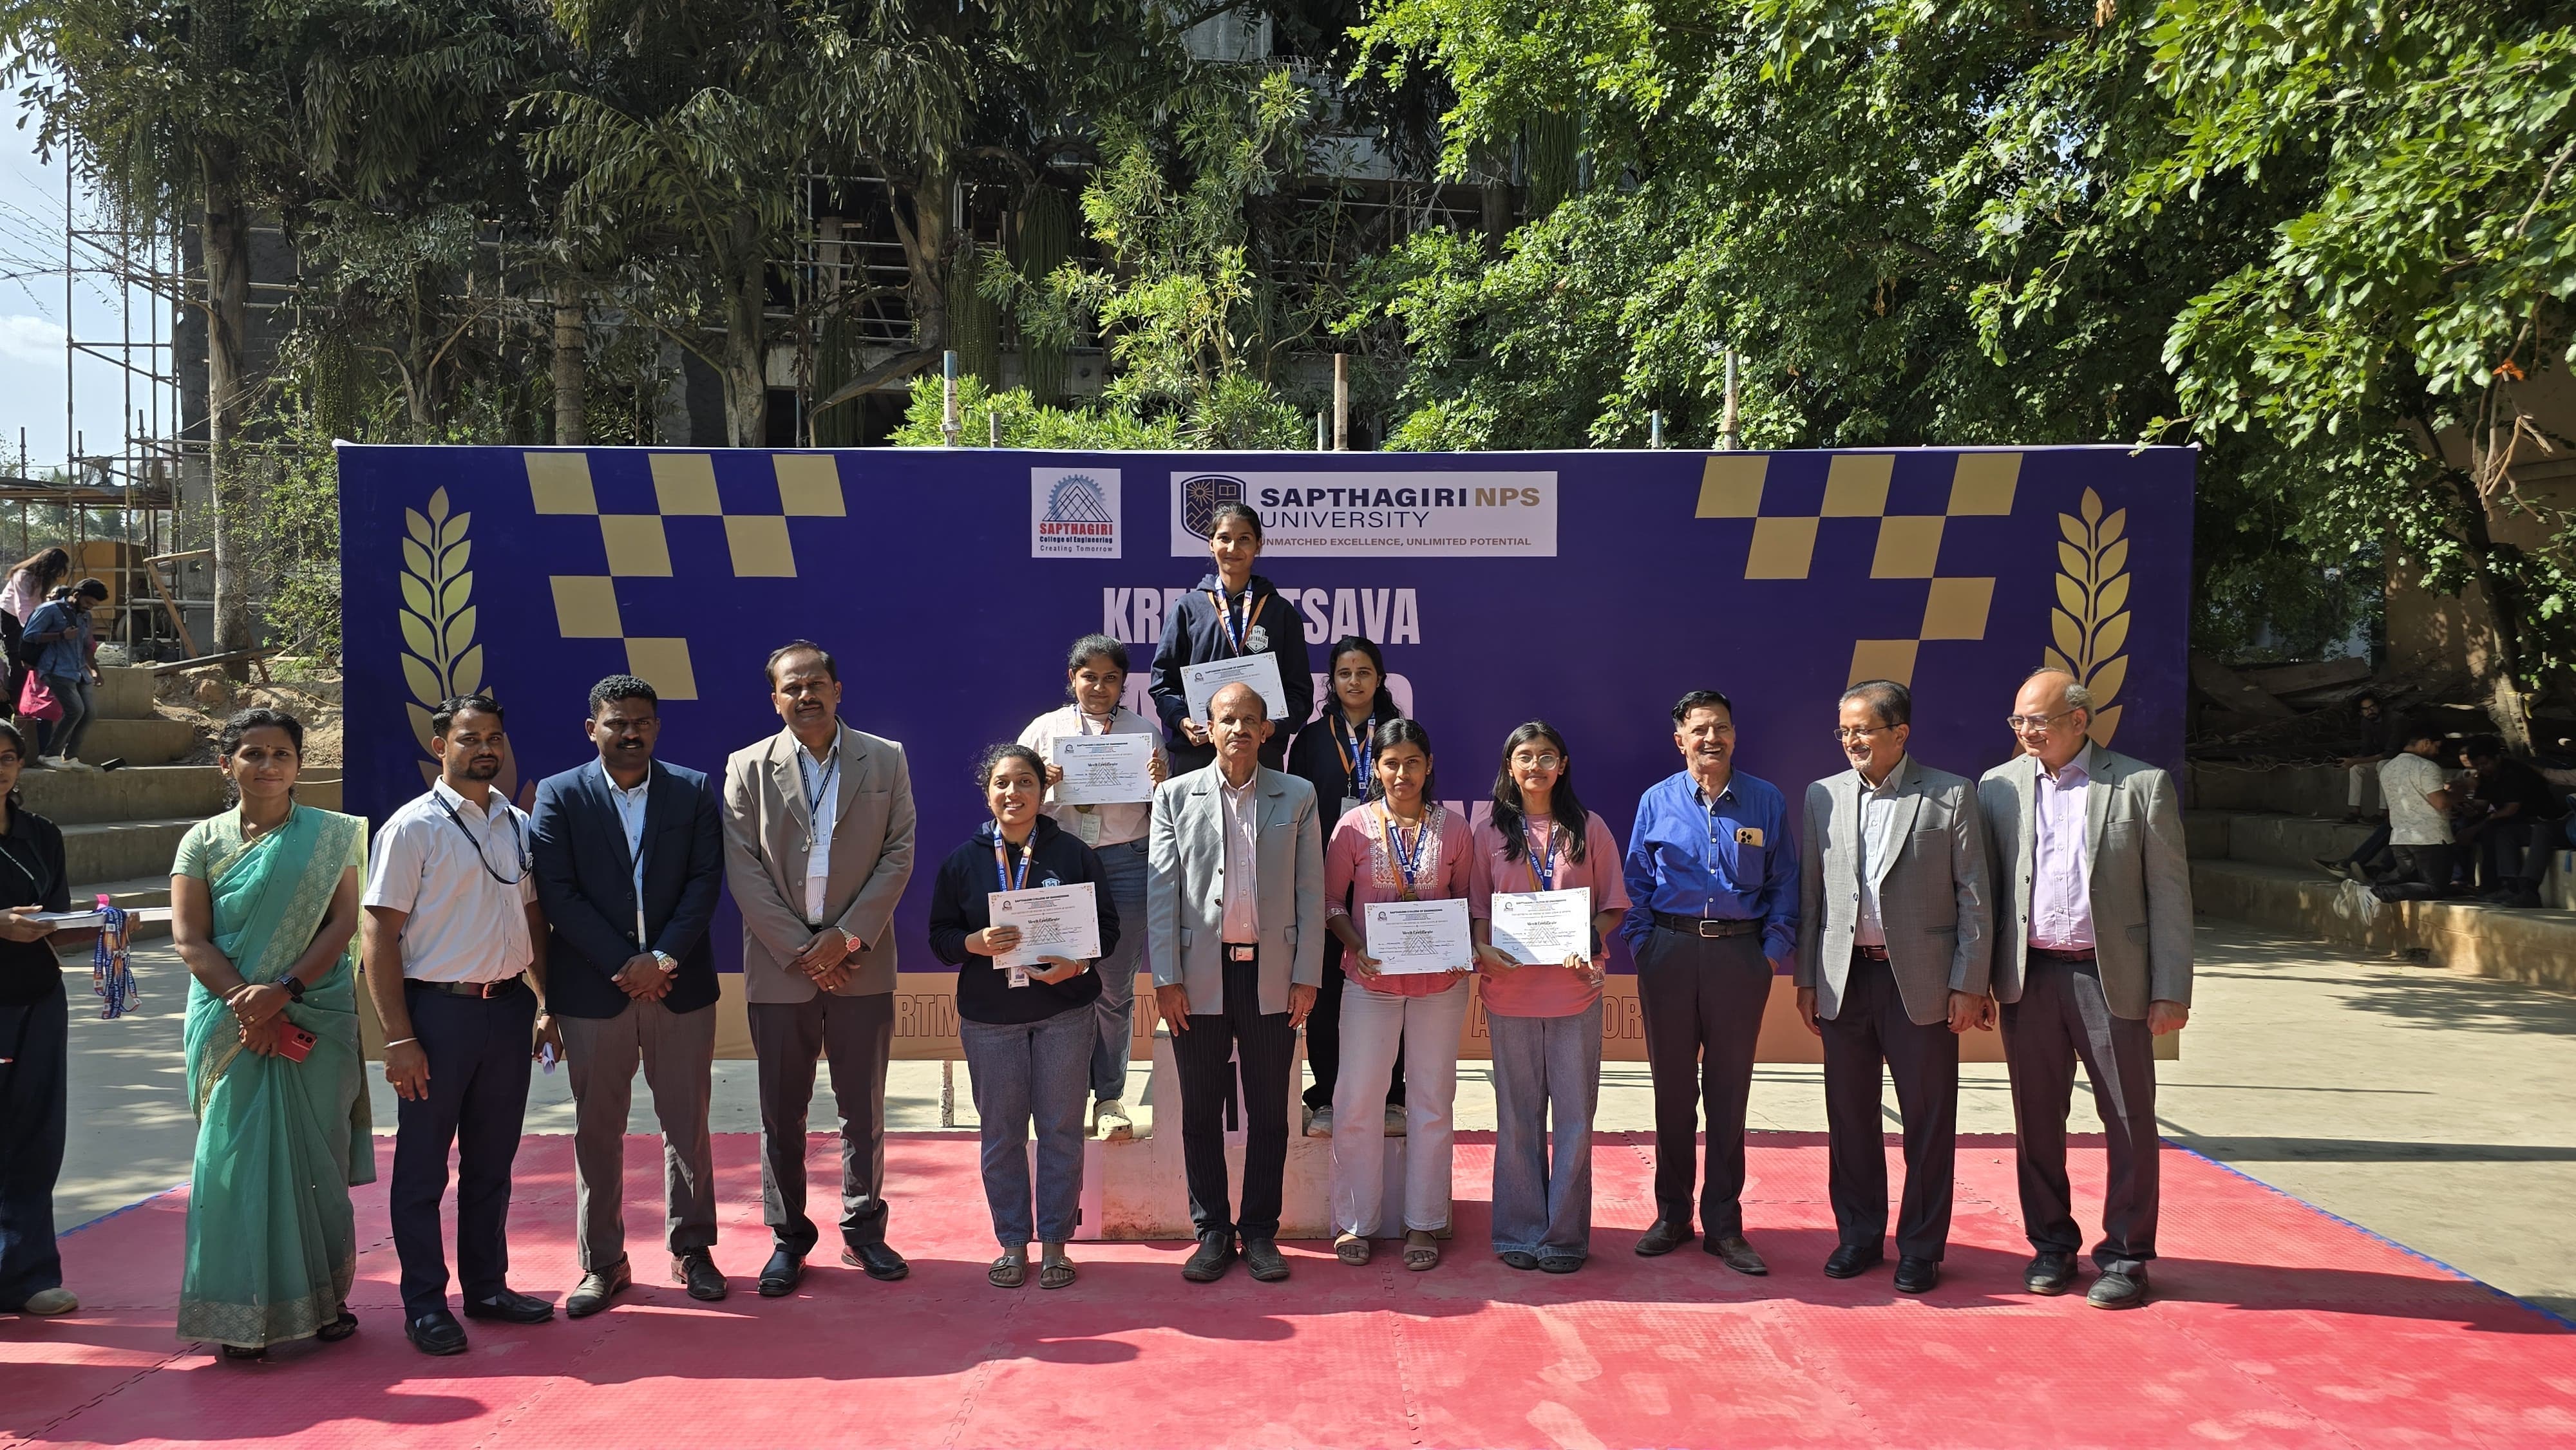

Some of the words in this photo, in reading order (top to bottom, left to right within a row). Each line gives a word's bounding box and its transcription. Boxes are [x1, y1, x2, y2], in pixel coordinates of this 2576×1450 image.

[1260, 487, 1467, 507] SAPTHAGIRI
[1475, 487, 1540, 507] NPS
[1260, 511, 1430, 528] UNIVERSITY
[1039, 523, 1113, 535] SAPTHAGIRI
[1261, 538, 1327, 546] UNMATCHED
[1331, 538, 1403, 547] EXCELLENCE,
[1407, 538, 1467, 546] UNLIMITED
[1470, 538, 1531, 546] POTENTIAL
